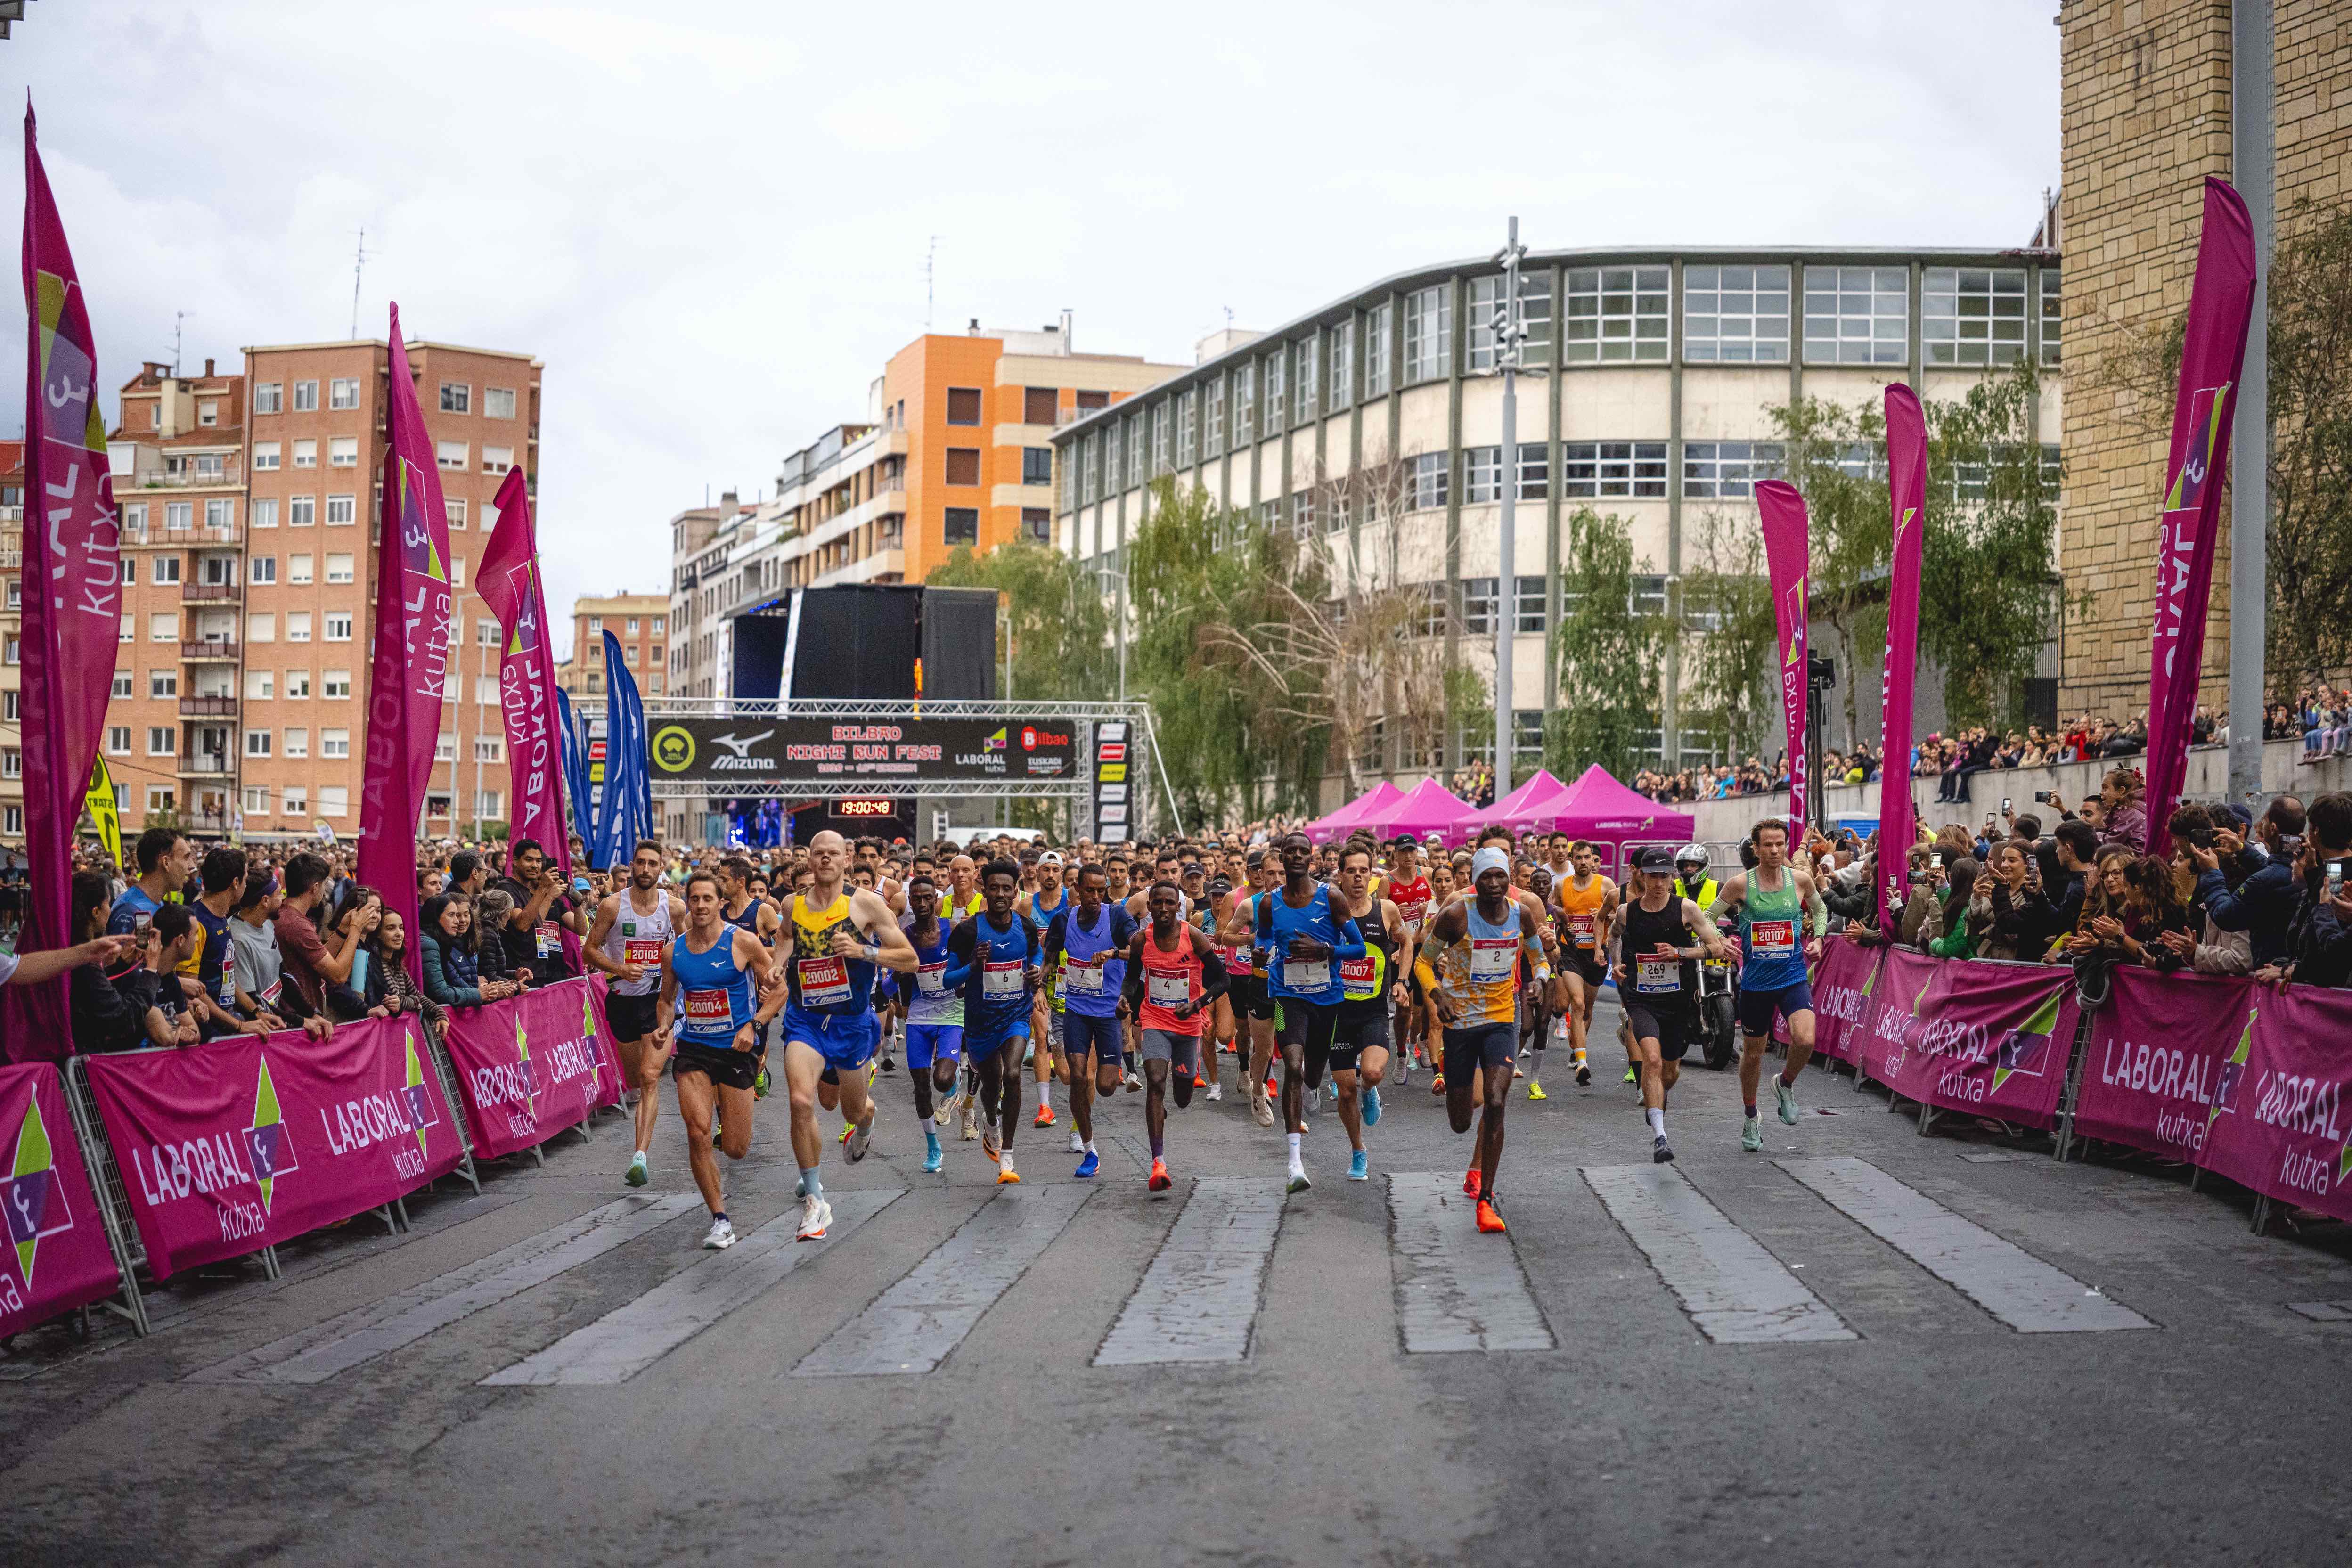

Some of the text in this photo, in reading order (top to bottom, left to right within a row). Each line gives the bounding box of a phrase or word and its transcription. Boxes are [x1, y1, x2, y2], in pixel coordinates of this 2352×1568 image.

[417, 593, 450, 698] kutxa
[832, 726, 902, 741] BILBAO
[1023, 731, 1068, 746] Bilbao
[787, 745, 941, 760] NIGHT RUN FEST
[956, 754, 1006, 765] LABORAL
[1027, 757, 1062, 765] EUSKADI
[841, 801, 890, 814] 19:00:48
[1759, 930, 1786, 941] 20107
[632, 949, 659, 960] 20102
[1494, 951, 1500, 962] 2
[806, 968, 839, 985] 20002
[932, 972, 939, 981] 5
[1080, 970, 1085, 978] 7
[1304, 964, 1308, 975] 1
[1339, 964, 1369, 977] 20007
[1648, 964, 1665, 974] 269
[1003, 972, 1008, 982] 6
[1164, 980, 1170, 990] 4
[691, 1000, 722, 1013] 20004
[544, 1038, 588, 1084] LABORAL
[2102, 1038, 2210, 1104] LABORAL
[470, 1063, 524, 1109] ABORAL
[1938, 1067, 1984, 1103] kutxa
[2255, 1069, 2340, 1141] LABORAL
[320, 1090, 412, 1155] LABORAL
[506, 1111, 536, 1139] kutxa
[2156, 1107, 2205, 1150] kutxa
[132, 1132, 251, 1206] LABORAL
[392, 1147, 425, 1182] kutxa
[2279, 1144, 2330, 1196] kutxa
[217, 1200, 266, 1244] kutxa
